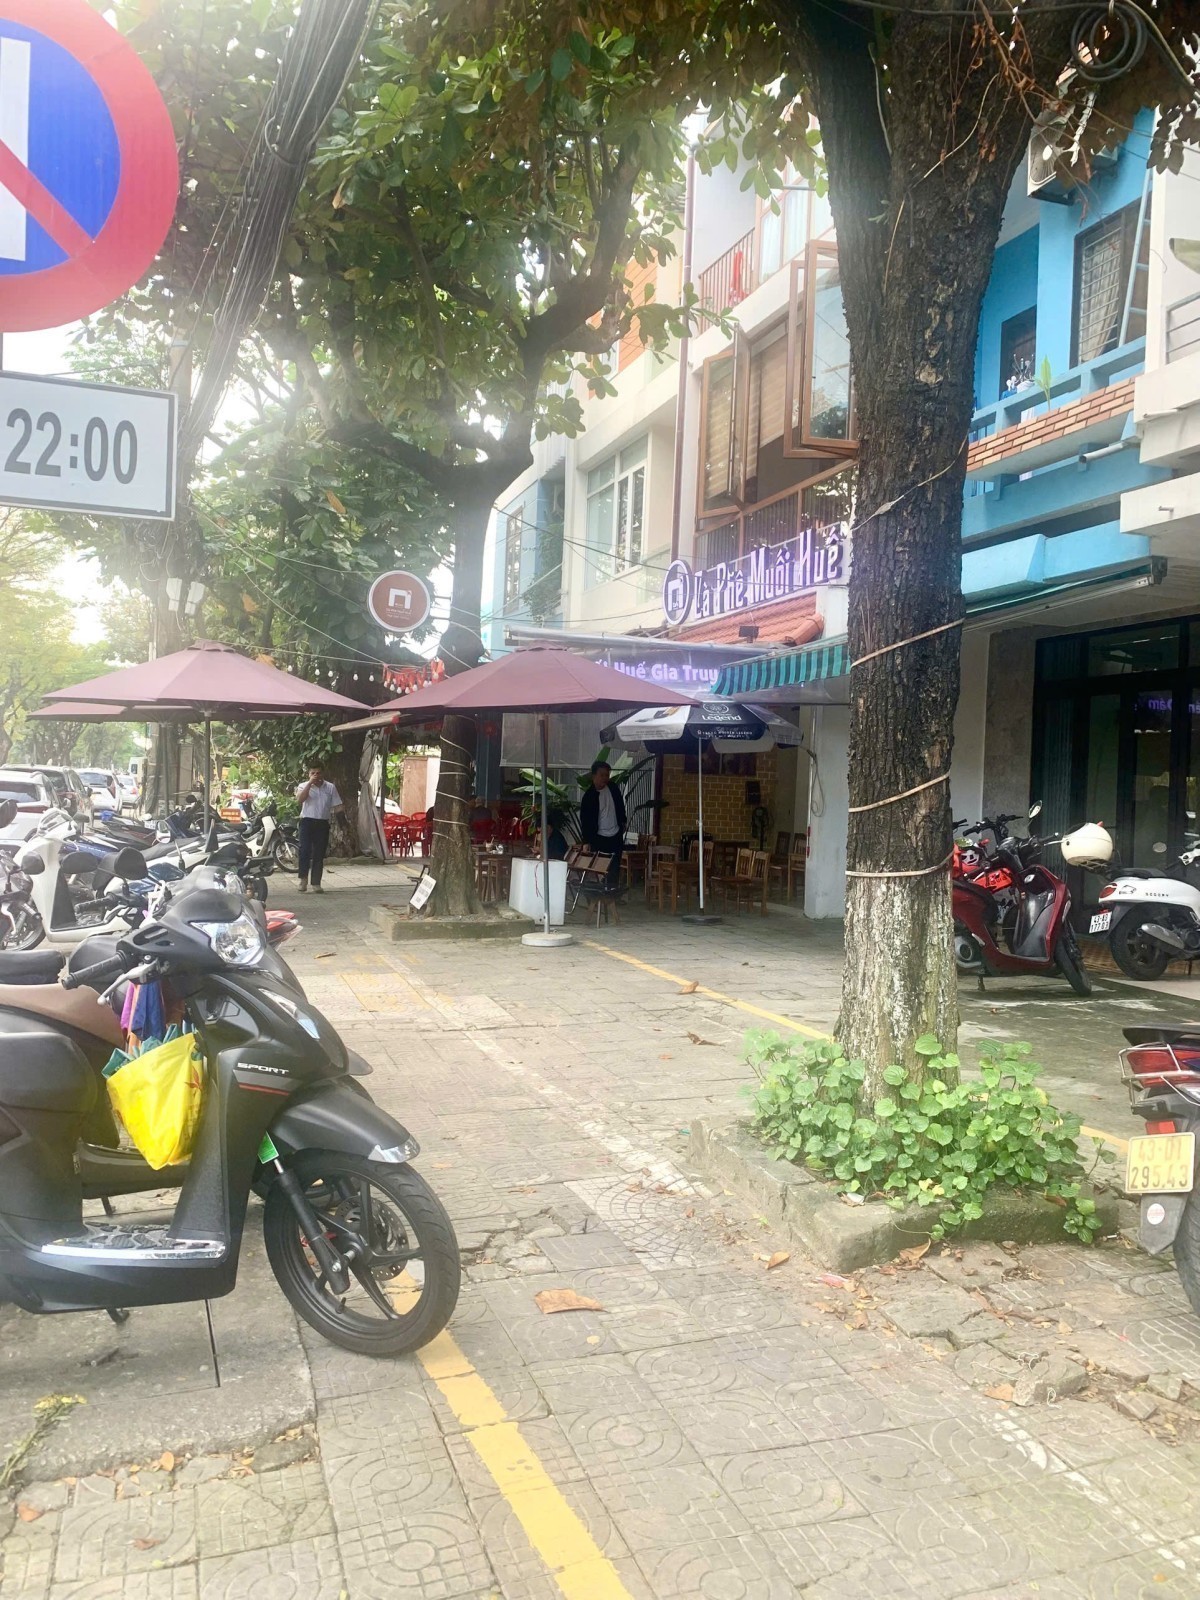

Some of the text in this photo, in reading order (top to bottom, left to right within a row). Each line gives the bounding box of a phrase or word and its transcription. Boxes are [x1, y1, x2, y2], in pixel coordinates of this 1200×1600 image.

[4, 408, 138, 485] 22:00
[694, 526, 841, 619] Cà Phê Muối Huế
[651, 663, 678, 681] Gia
[237, 1062, 289, 1074] SPORT
[1130, 1163, 1188, 1189] 295.43
